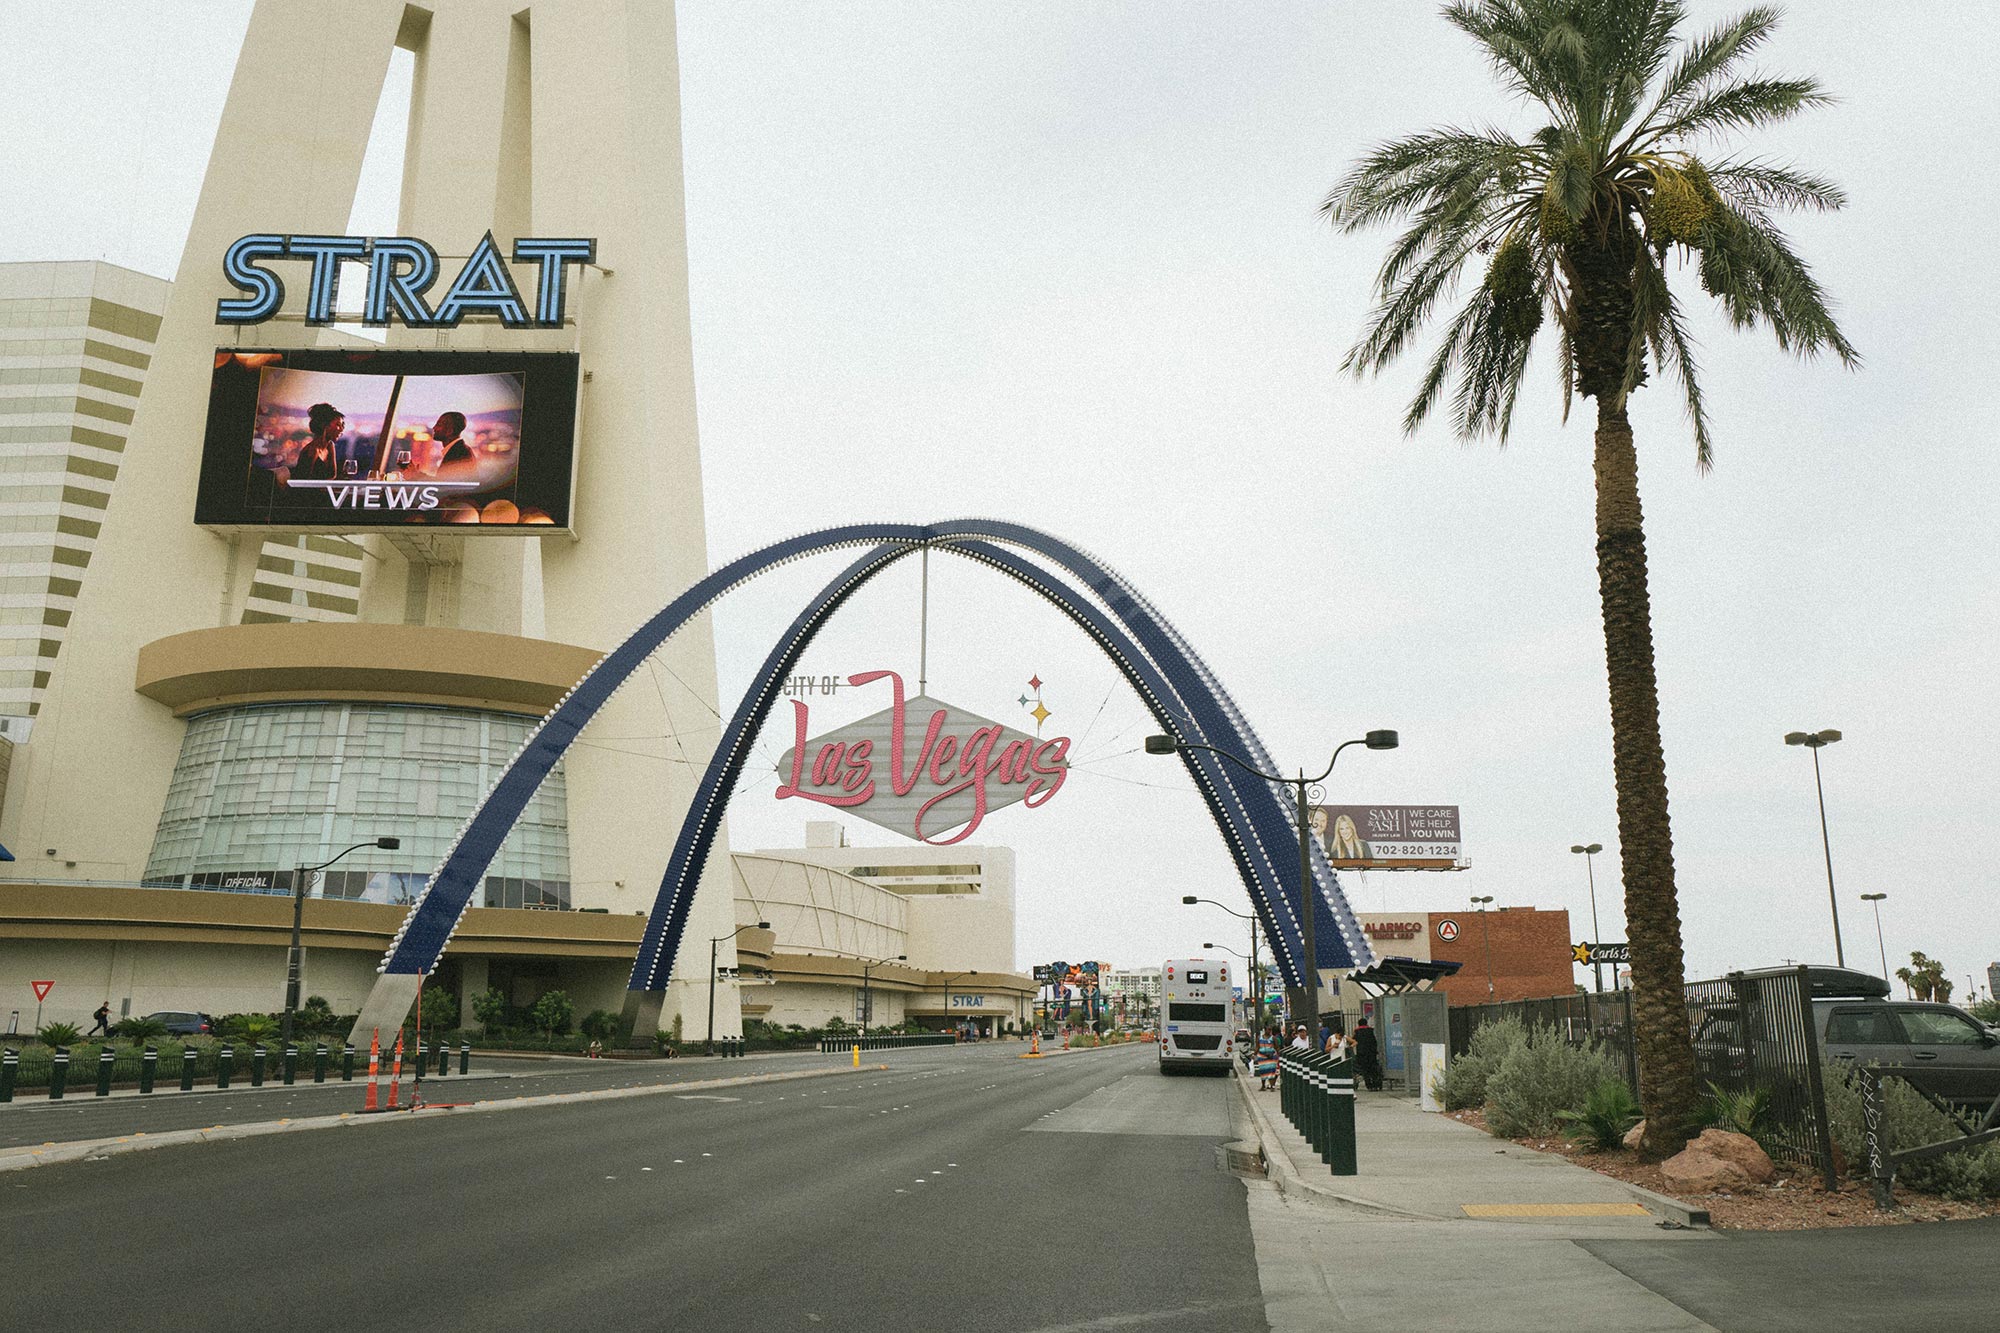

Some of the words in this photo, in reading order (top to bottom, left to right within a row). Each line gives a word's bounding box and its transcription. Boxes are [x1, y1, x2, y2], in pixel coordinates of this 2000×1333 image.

[215, 229, 597, 329] STRAT
[327, 485, 440, 511] VIEWS
[784, 676, 815, 696] CITY
[821, 676, 839, 695] OF
[775, 699, 875, 807] Las
[847, 670, 1071, 846] Vegas
[1369, 809, 1400, 820] SAM
[1409, 809, 1425, 818] WE
[1426, 809, 1454, 818] CARE.
[1410, 819, 1425, 828] WE
[1427, 819, 1452, 828] HELP.
[1411, 829, 1432, 838] YOU
[1434, 829, 1457, 838] WIN.
[1375, 845, 1458, 855] 702-820-1234
[225, 877, 267, 888] OFFICIAL
[1364, 922, 1422, 933] ALARMCO
[1590, 946, 1620, 960] Carl's
[952, 995, 985, 1007] STRAT
